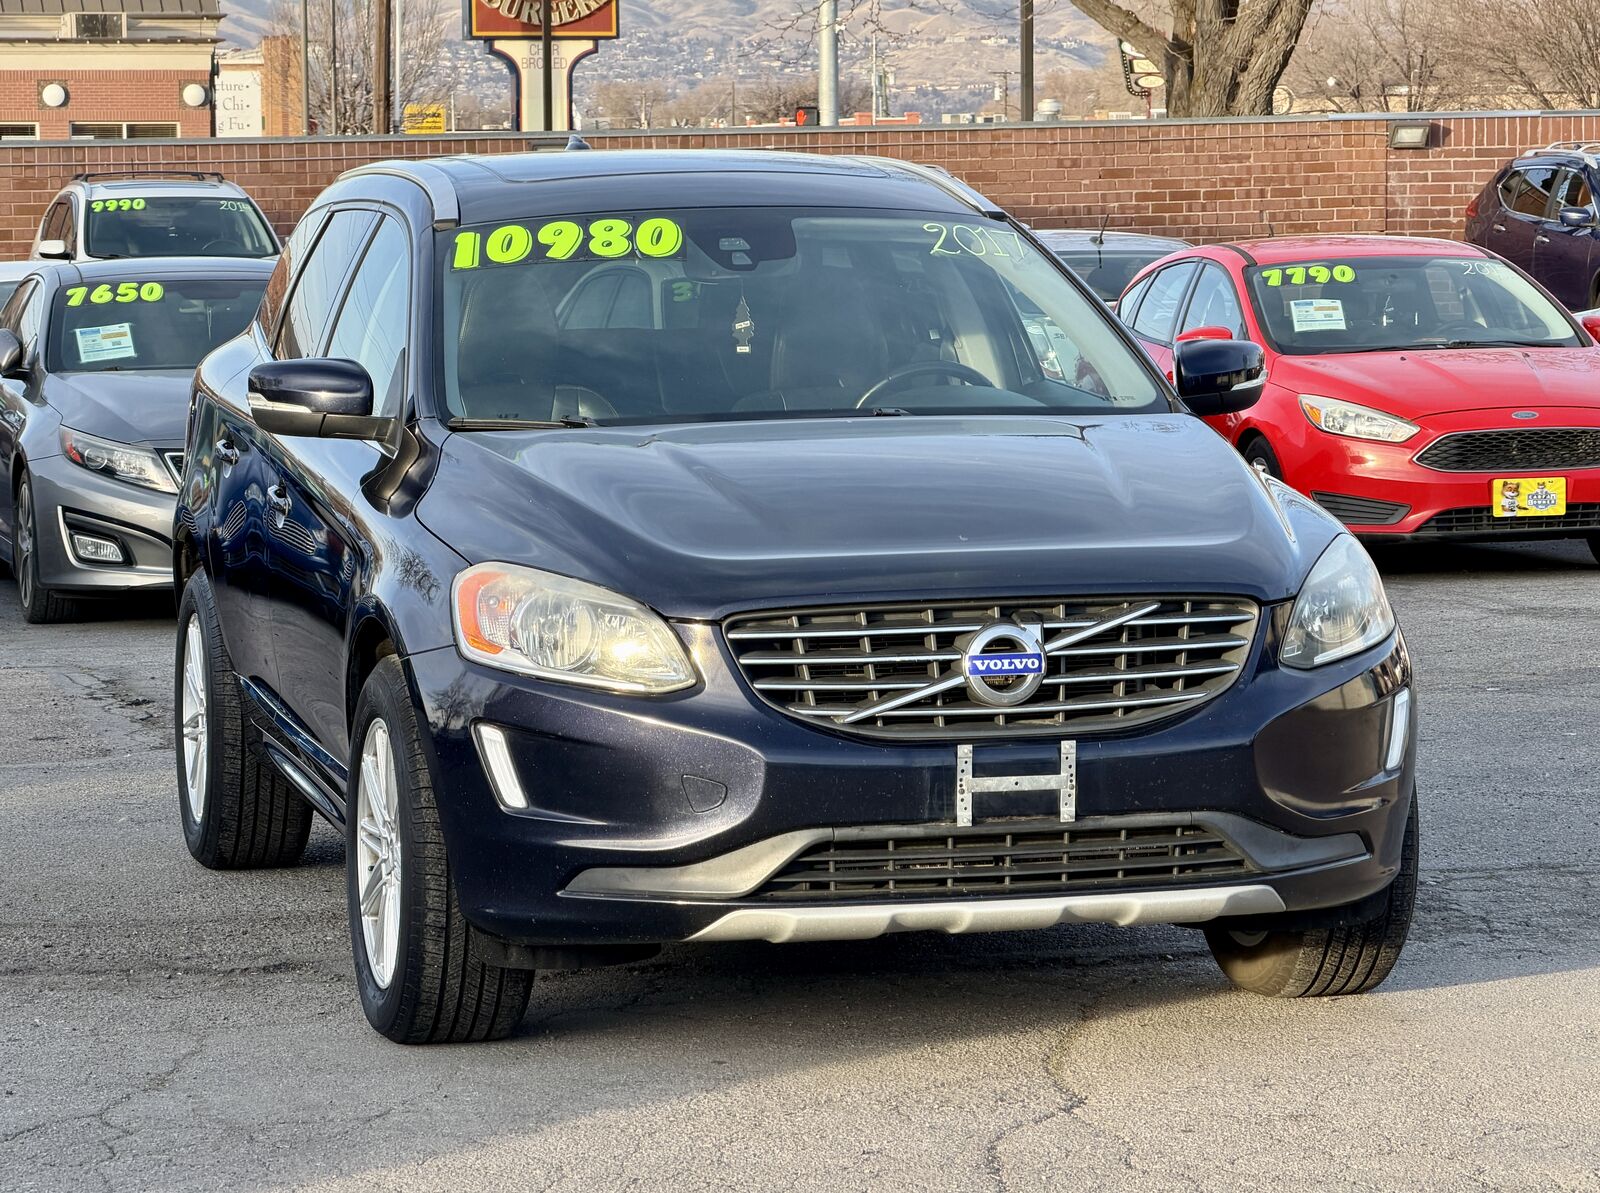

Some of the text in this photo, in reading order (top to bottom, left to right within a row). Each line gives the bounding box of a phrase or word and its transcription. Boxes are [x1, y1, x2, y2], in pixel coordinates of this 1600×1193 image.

[529, 43, 560, 56] CHR
[521, 57, 568, 70] BROED
[222, 95, 244, 111] Chi
[229, 116, 245, 130] Fu
[91, 198, 146, 213] 9990
[453, 217, 683, 269] 10980
[923, 223, 1025, 259] 2017
[1262, 264, 1356, 287] 7790
[65, 282, 164, 307] 7650
[972, 658, 1040, 671] VOLVO
